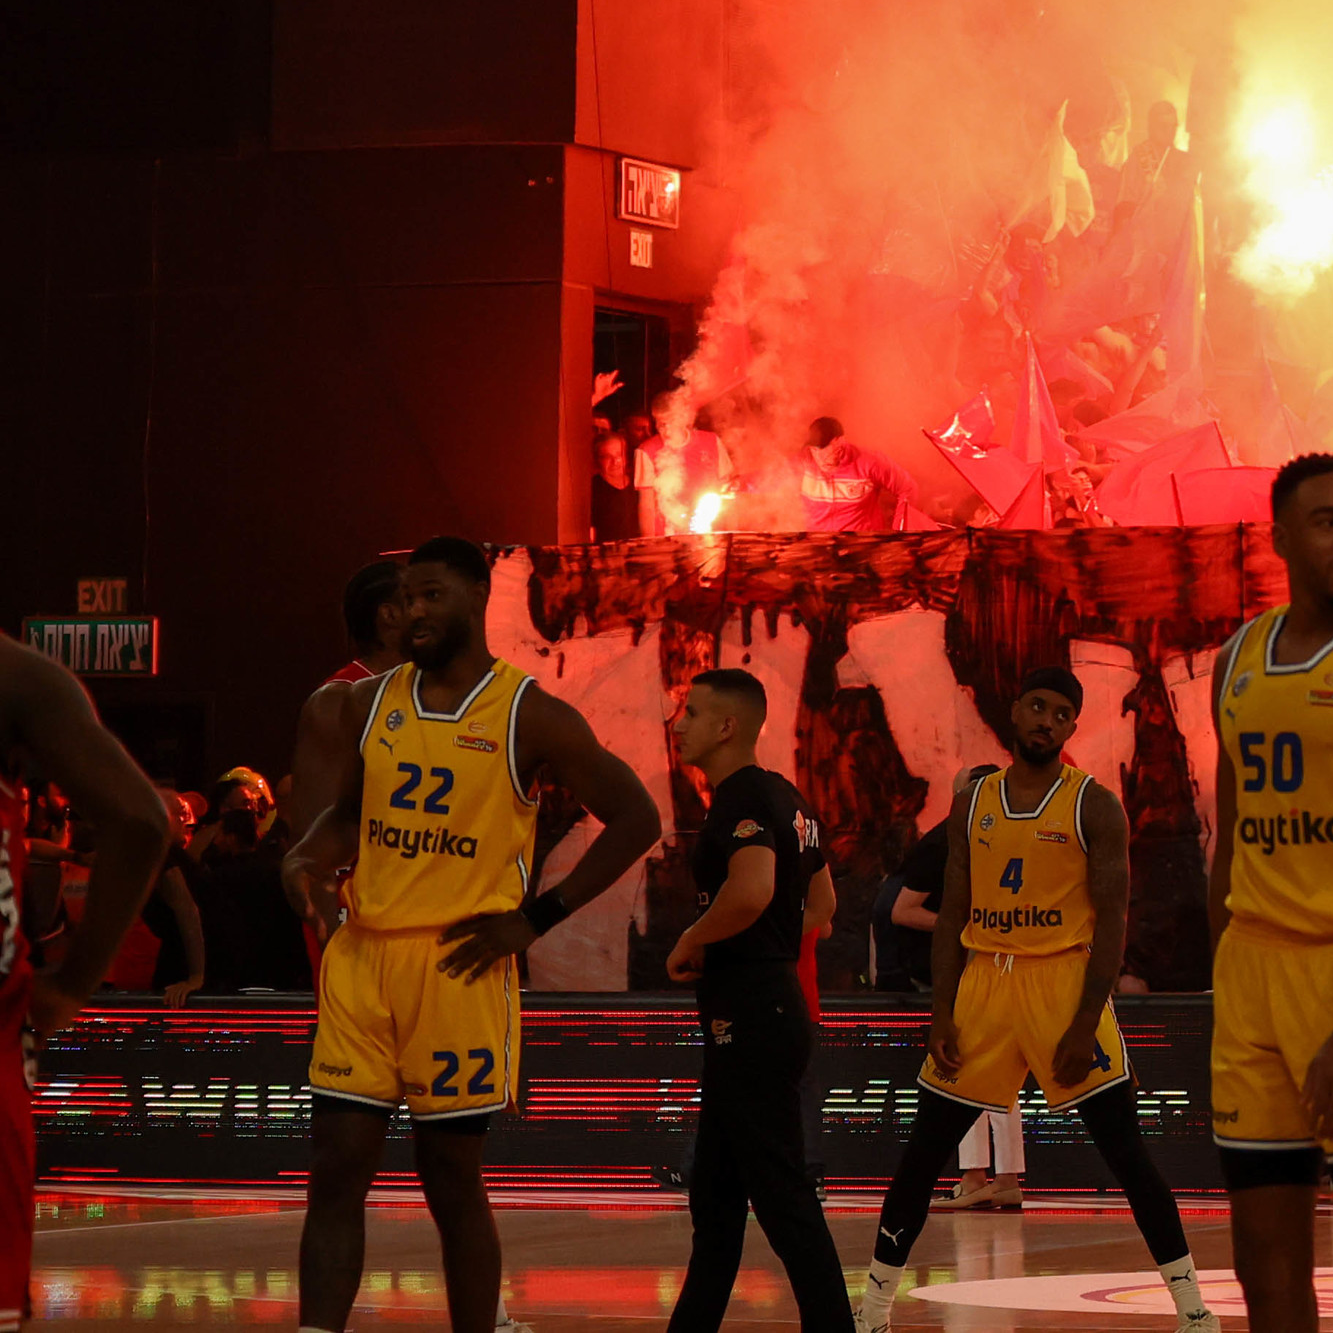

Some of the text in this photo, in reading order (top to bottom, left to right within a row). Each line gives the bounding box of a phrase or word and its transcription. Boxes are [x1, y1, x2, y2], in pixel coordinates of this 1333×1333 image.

[78, 580, 127, 613] EXIT
[95, 623, 149, 671] יציאת
[1239, 732, 1304, 793] 50
[389, 762, 454, 815] 22
[368, 819, 478, 859] Playtika
[1000, 858, 1024, 895] 4
[973, 906, 1063, 934] Playtika
[431, 1050, 495, 1097] 22
